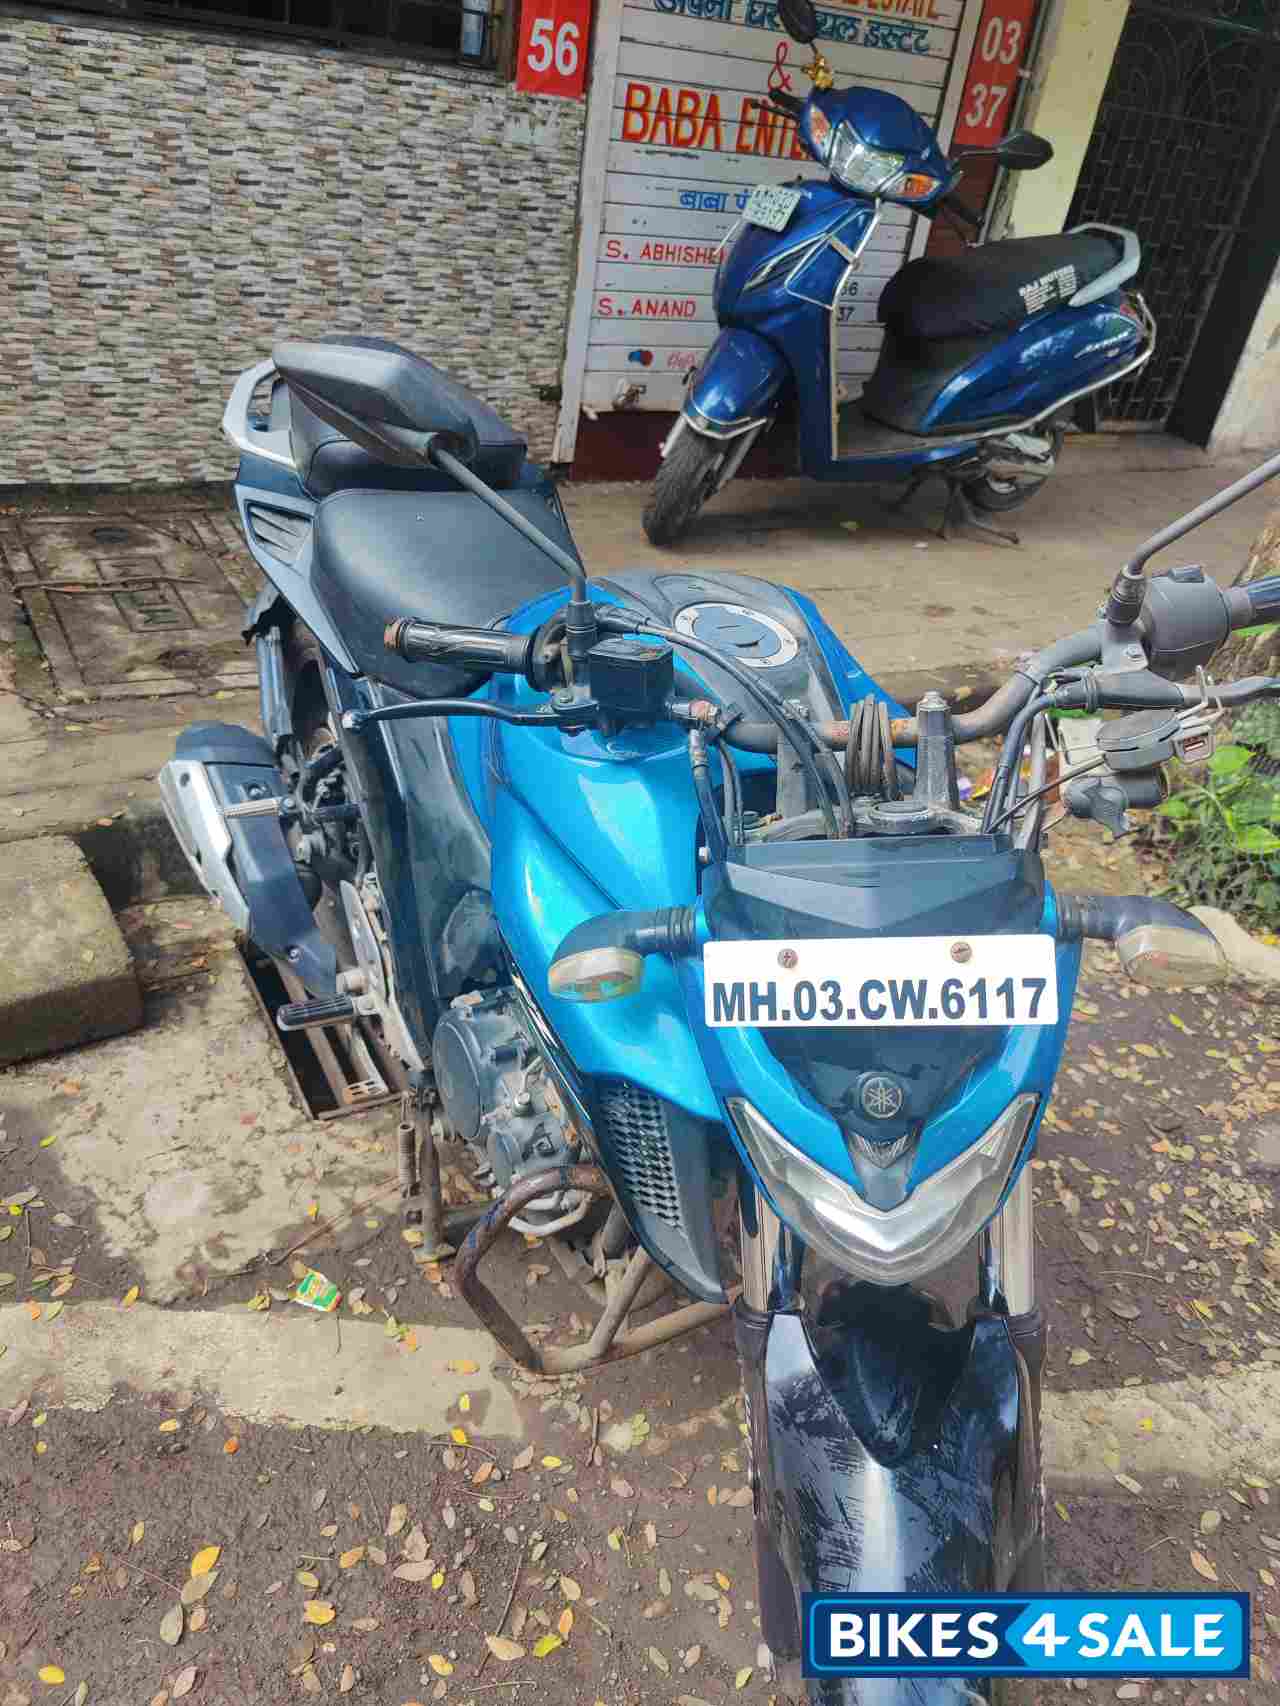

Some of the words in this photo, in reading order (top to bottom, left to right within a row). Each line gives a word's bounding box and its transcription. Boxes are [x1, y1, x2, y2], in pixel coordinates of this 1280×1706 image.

[527, 18, 580, 76] 56
[982, 16, 1021, 64] 03
[769, 41, 791, 91] &
[622, 81, 721, 152] BABA
[965, 83, 1008, 128] 37
[607, 239, 629, 260] S.
[597, 297, 624, 316] S.
[631, 298, 697, 319] ANAND
[712, 977, 1047, 1023] MH.03.CW.6117
